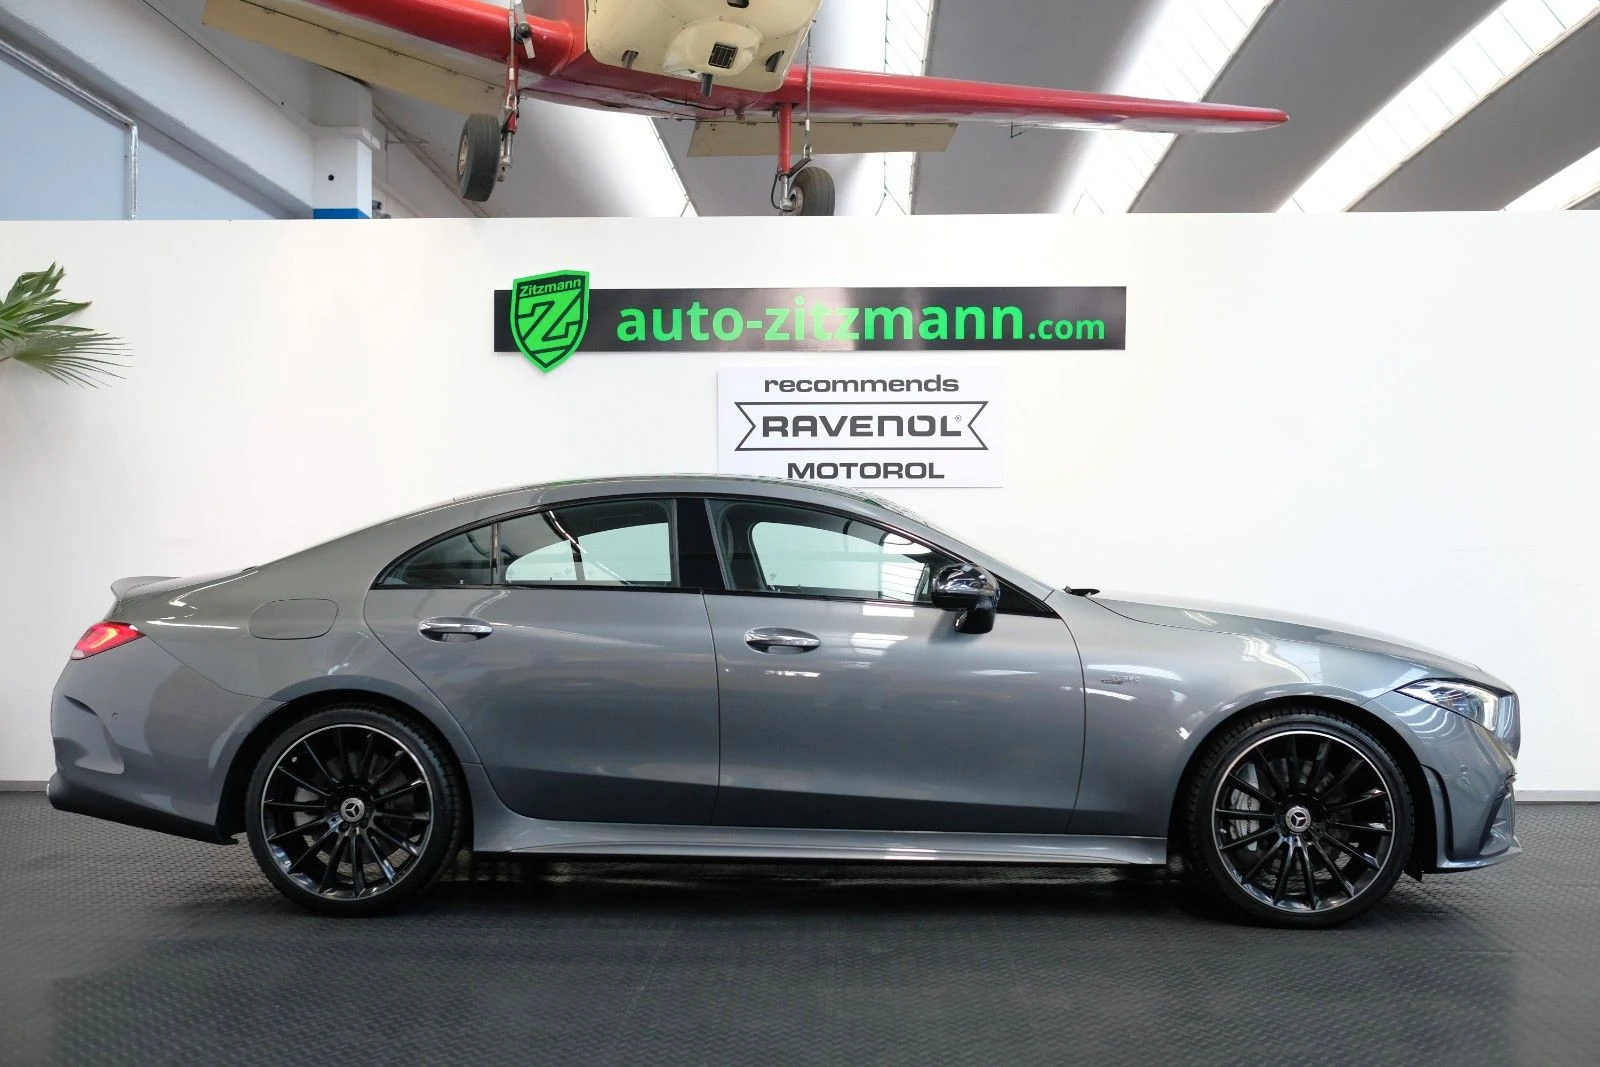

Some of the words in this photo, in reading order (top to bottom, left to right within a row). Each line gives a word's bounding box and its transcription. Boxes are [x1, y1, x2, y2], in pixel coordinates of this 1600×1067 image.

[519, 278, 582, 298] Zitzmann
[616, 296, 1105, 343] auto-zitzmann.com
[764, 374, 960, 393] recommends
[787, 462, 945, 480] MOTOROL
